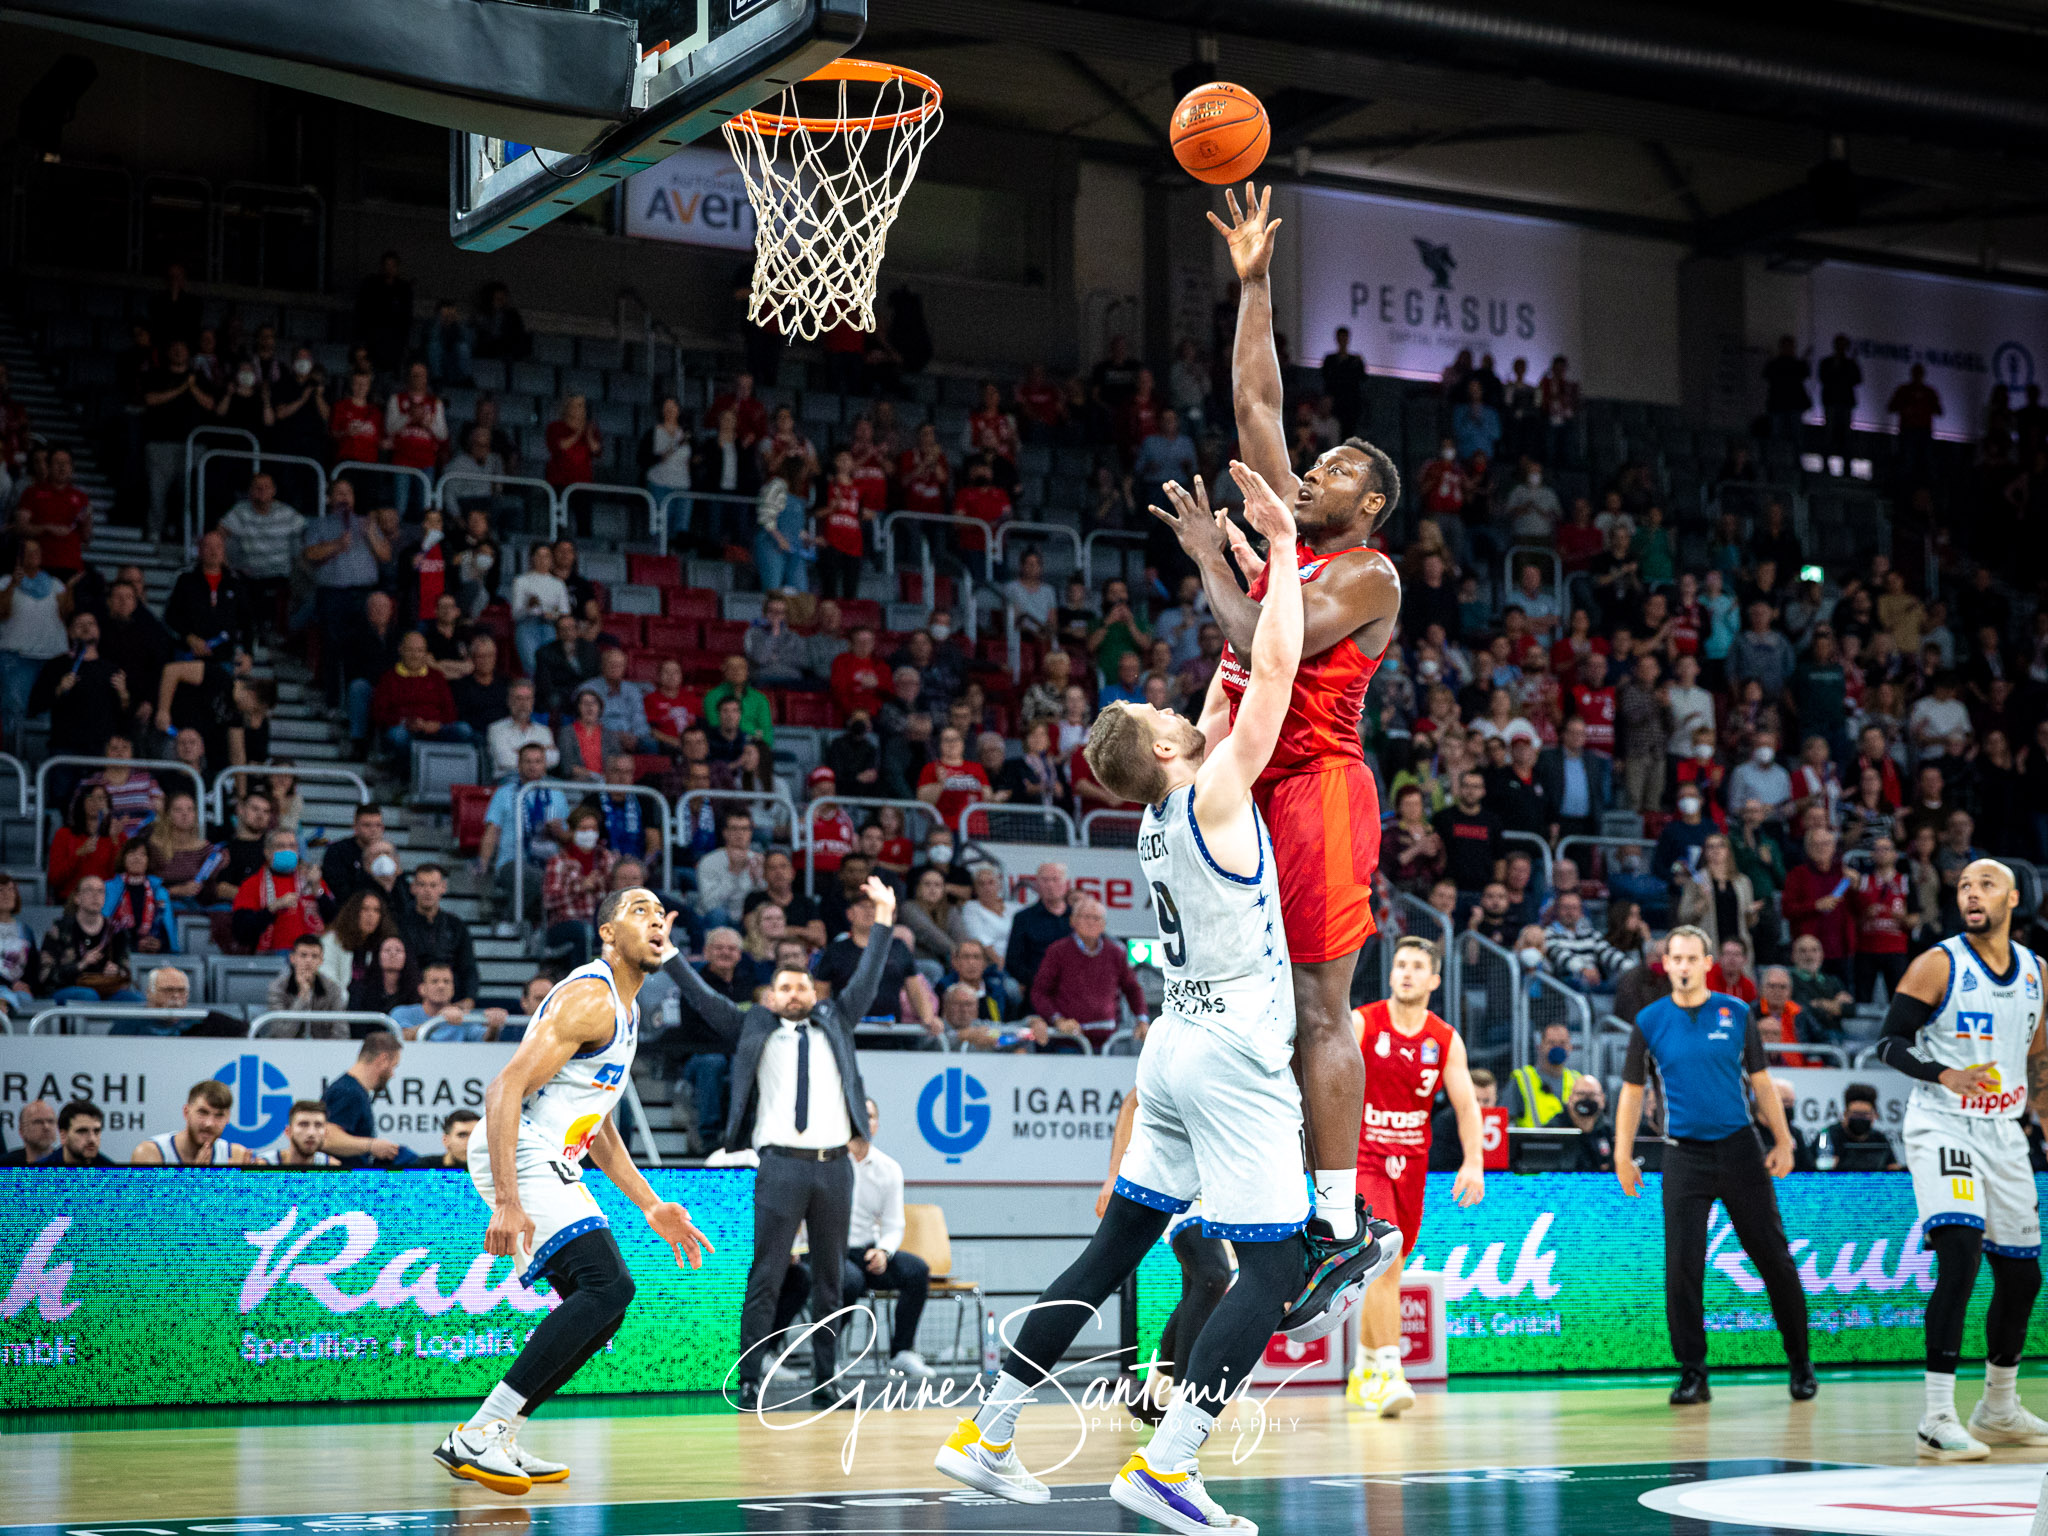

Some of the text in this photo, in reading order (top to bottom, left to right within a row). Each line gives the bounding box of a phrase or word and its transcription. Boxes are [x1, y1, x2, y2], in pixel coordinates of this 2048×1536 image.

[1350, 281, 1536, 339] PEGASUS
[1152, 880, 1187, 967] 9
[3, 1072, 146, 1102] RASHI
[321, 1078, 485, 1106] IARAS
[1014, 1088, 1124, 1114] IGARA
[378, 1114, 446, 1132] OREN
[1482, 1115, 1502, 1151] 5
[239, 1206, 564, 1316] Rau
[1, 1335, 76, 1366] mbH
[389, 1336, 407, 1356] +
